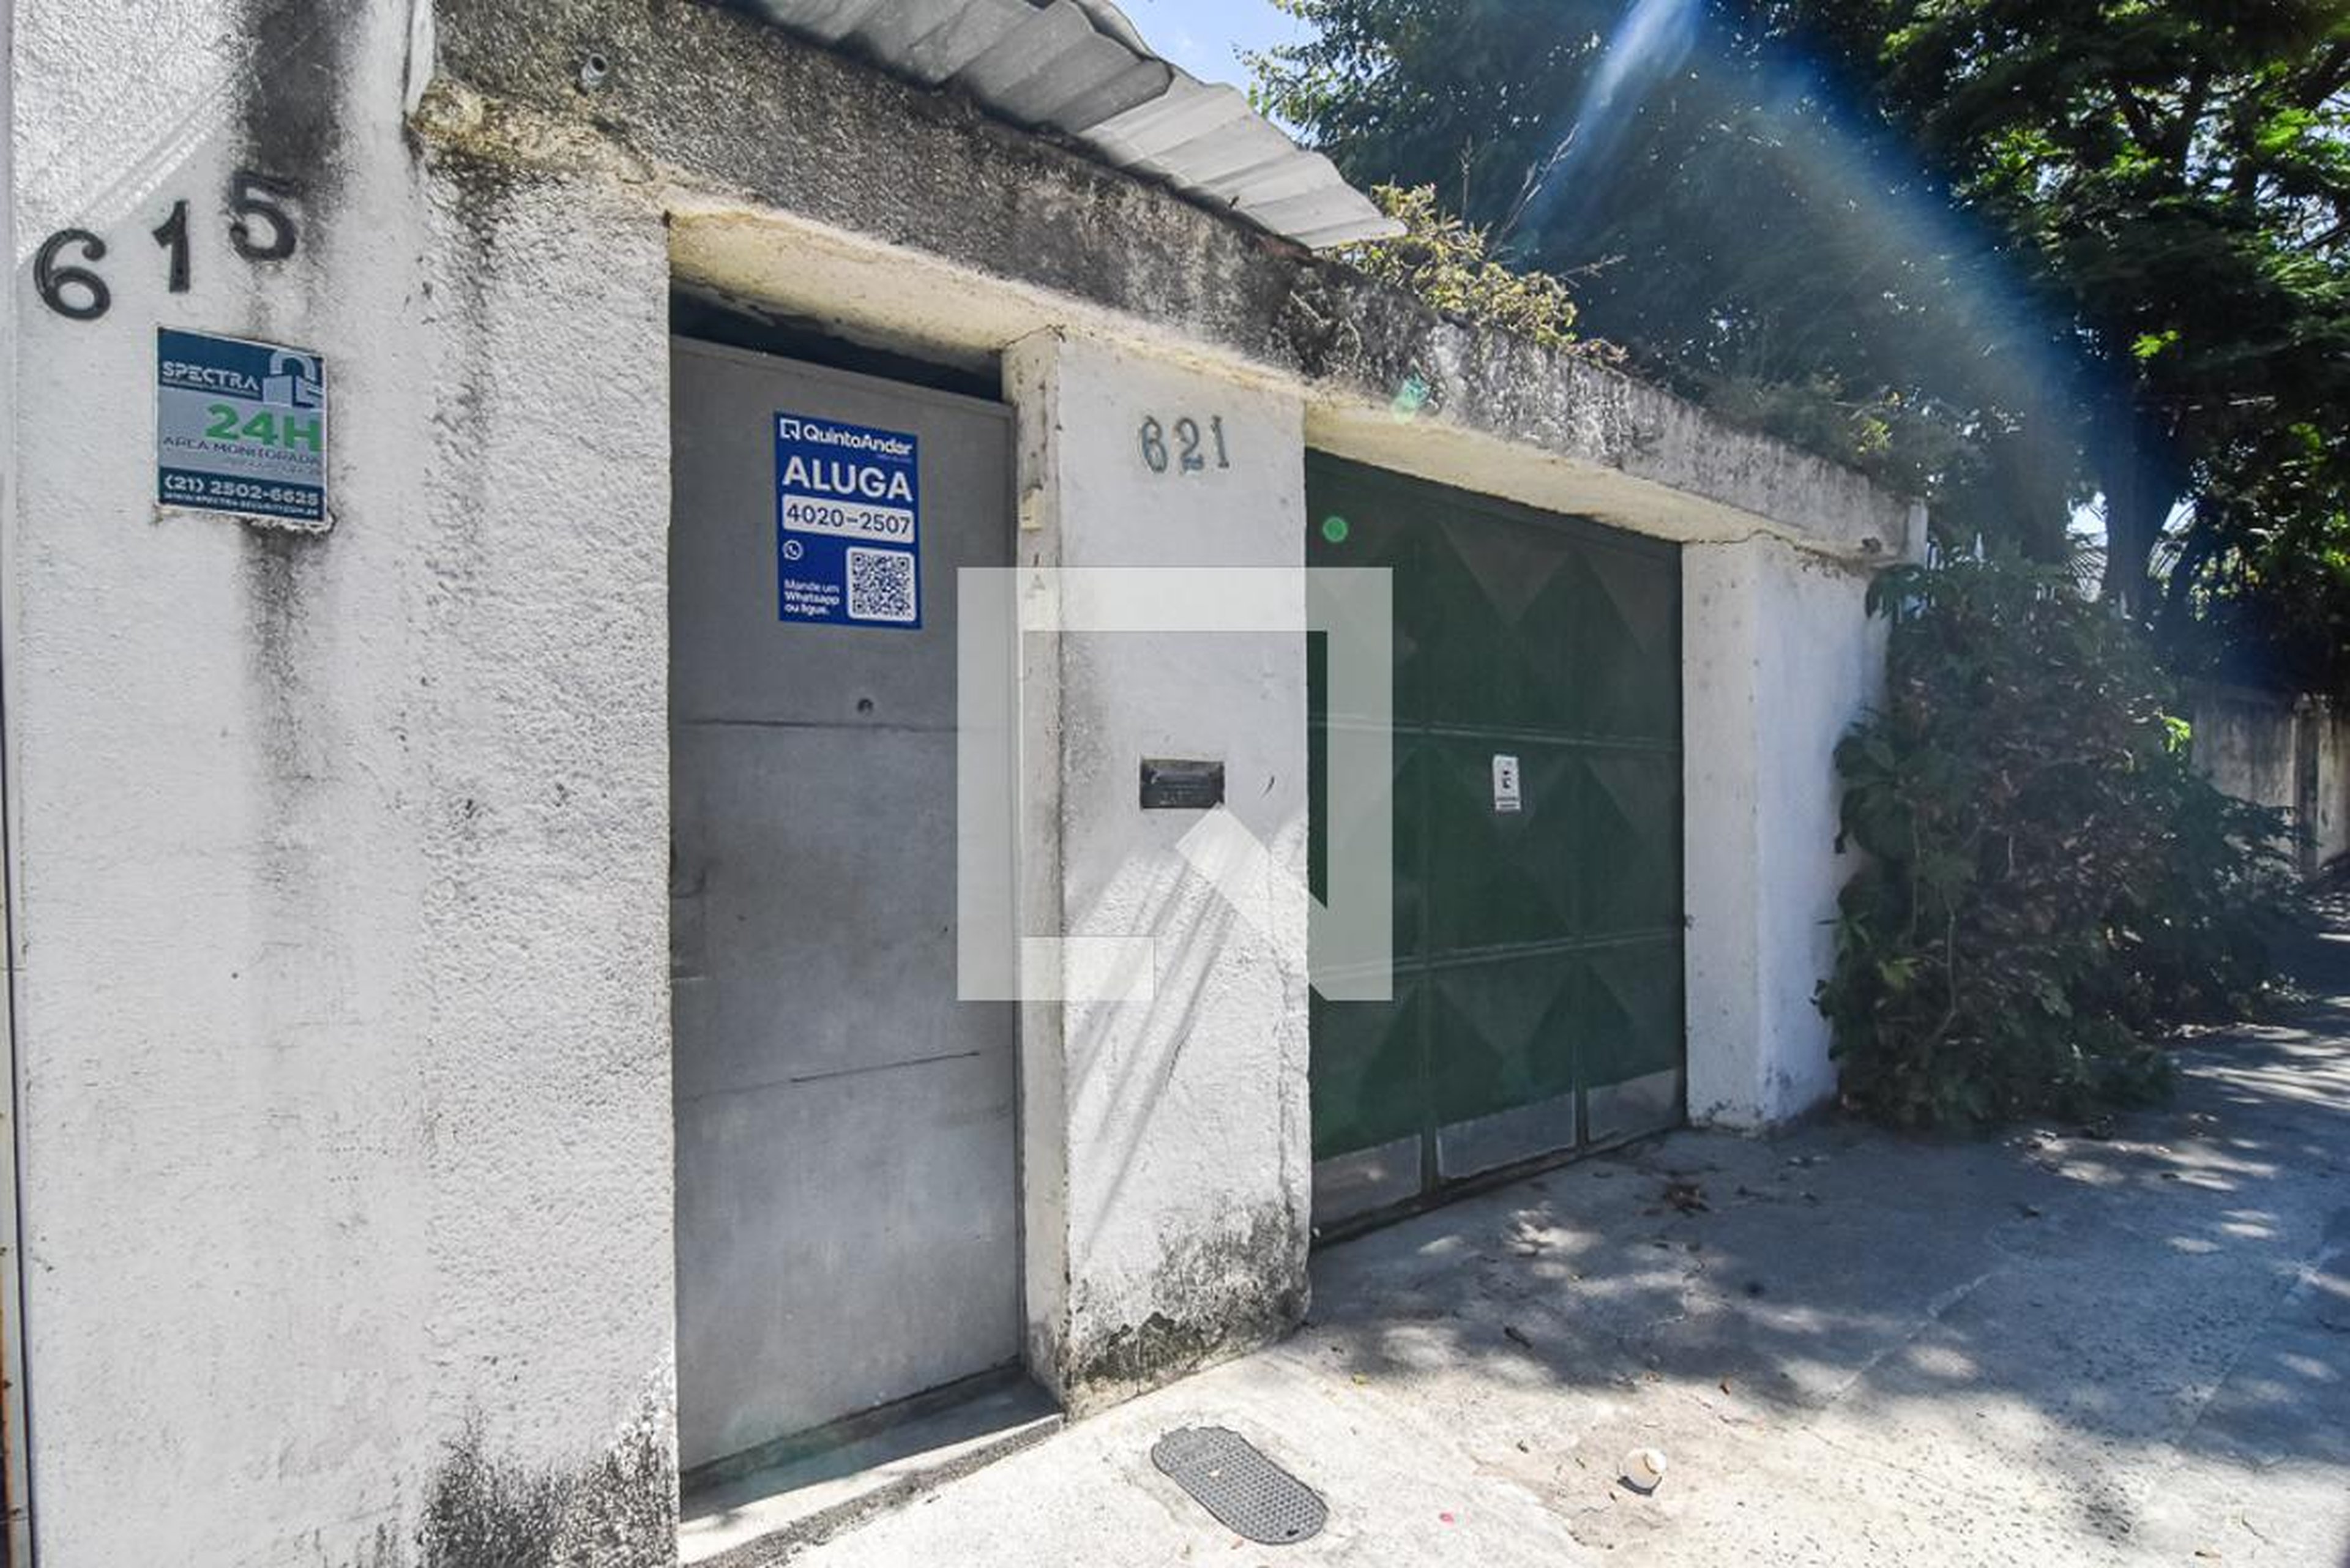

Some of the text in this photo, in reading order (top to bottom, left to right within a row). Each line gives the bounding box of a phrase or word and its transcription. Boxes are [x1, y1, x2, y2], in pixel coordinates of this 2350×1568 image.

[34, 166, 300, 321] 615
[163, 361, 259, 390] SPECTRA
[205, 403, 322, 452] 24H
[803, 424, 912, 455] QuintoAndar
[1140, 414, 1229, 474] 621
[164, 474, 204, 492] (21)
[781, 455, 913, 502] ALUGA
[786, 504, 911, 535] 4020-2507
[785, 603, 799, 613] ou
